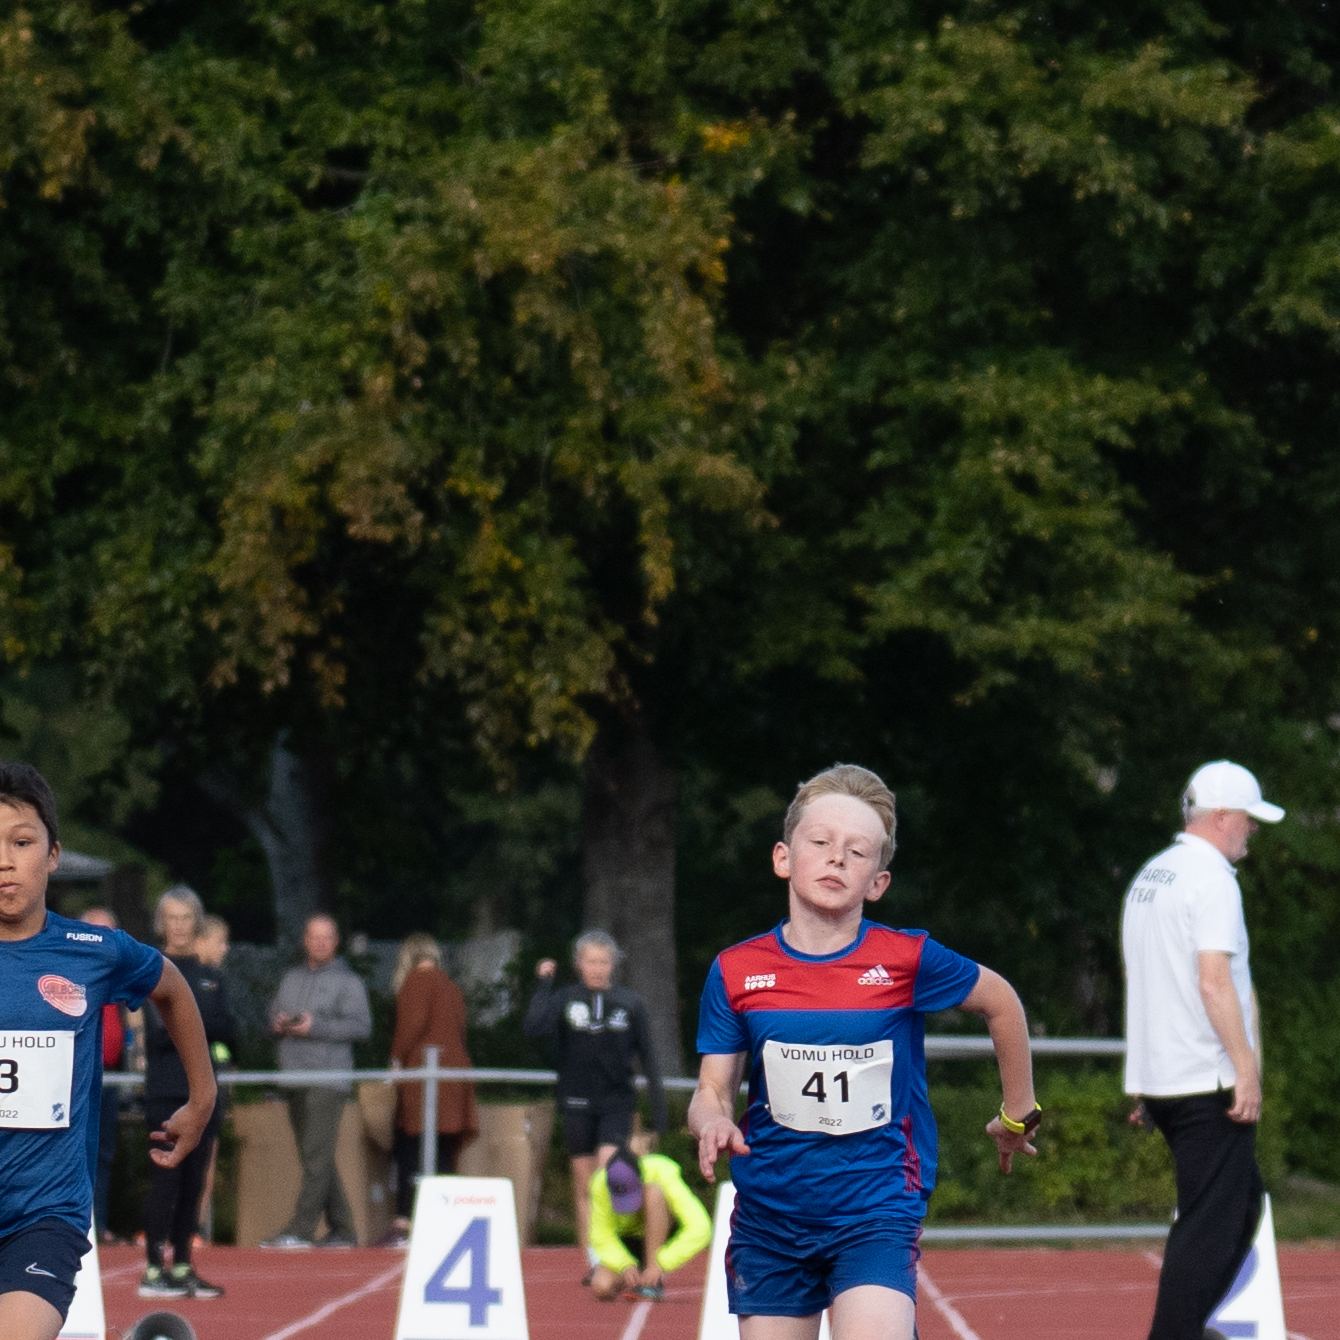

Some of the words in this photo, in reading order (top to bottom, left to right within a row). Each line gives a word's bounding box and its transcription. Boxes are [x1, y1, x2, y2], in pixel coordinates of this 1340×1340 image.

[1140, 868, 1177, 886] TARTER
[66, 932, 103, 943] FUSION
[744, 980, 776, 991] 1900
[857, 976, 895, 986] adidas
[12, 1036, 56, 1048] HOLD
[780, 1047, 827, 1062] VDMU
[832, 1047, 874, 1061] HOLD
[801, 1070, 849, 1103] 41
[818, 1116, 843, 1127] 2022
[423, 1216, 503, 1329] 4
